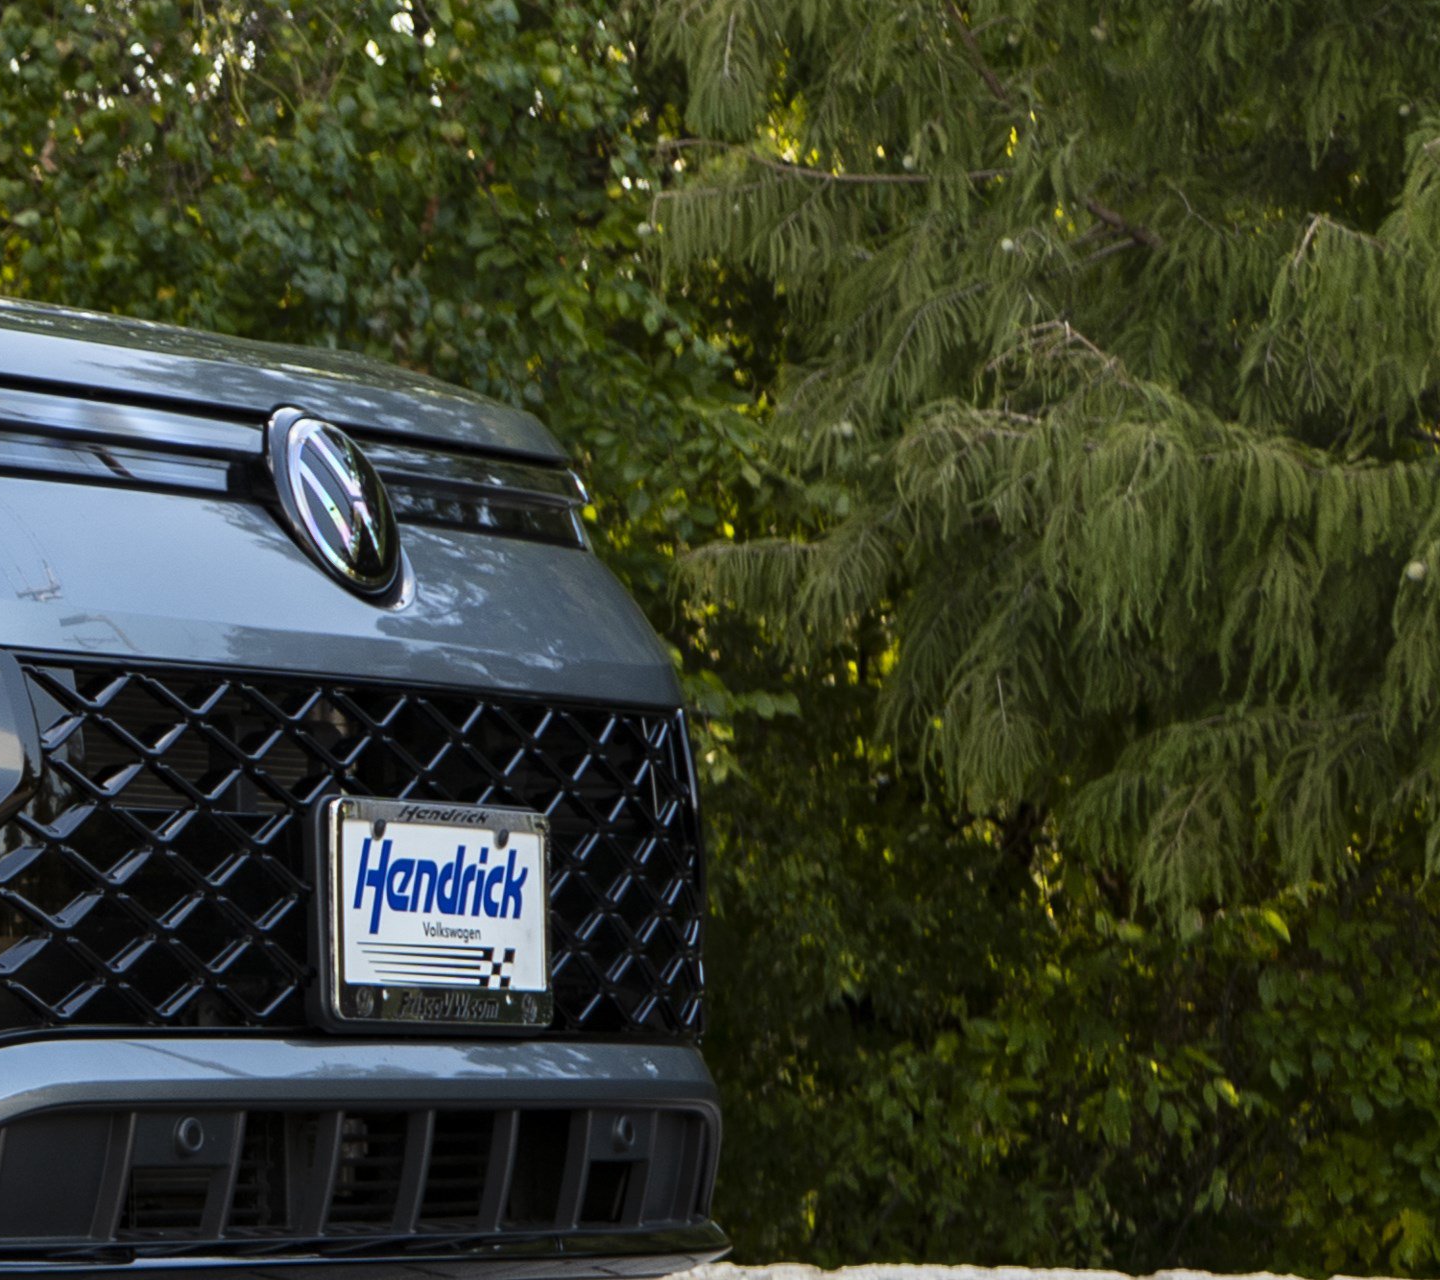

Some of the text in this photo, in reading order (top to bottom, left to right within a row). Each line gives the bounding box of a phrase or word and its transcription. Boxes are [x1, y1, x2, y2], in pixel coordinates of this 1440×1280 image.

[398, 805, 489, 824] Hendrick
[353, 838, 528, 934] Hendrick
[423, 922, 481, 943] Volkswagen
